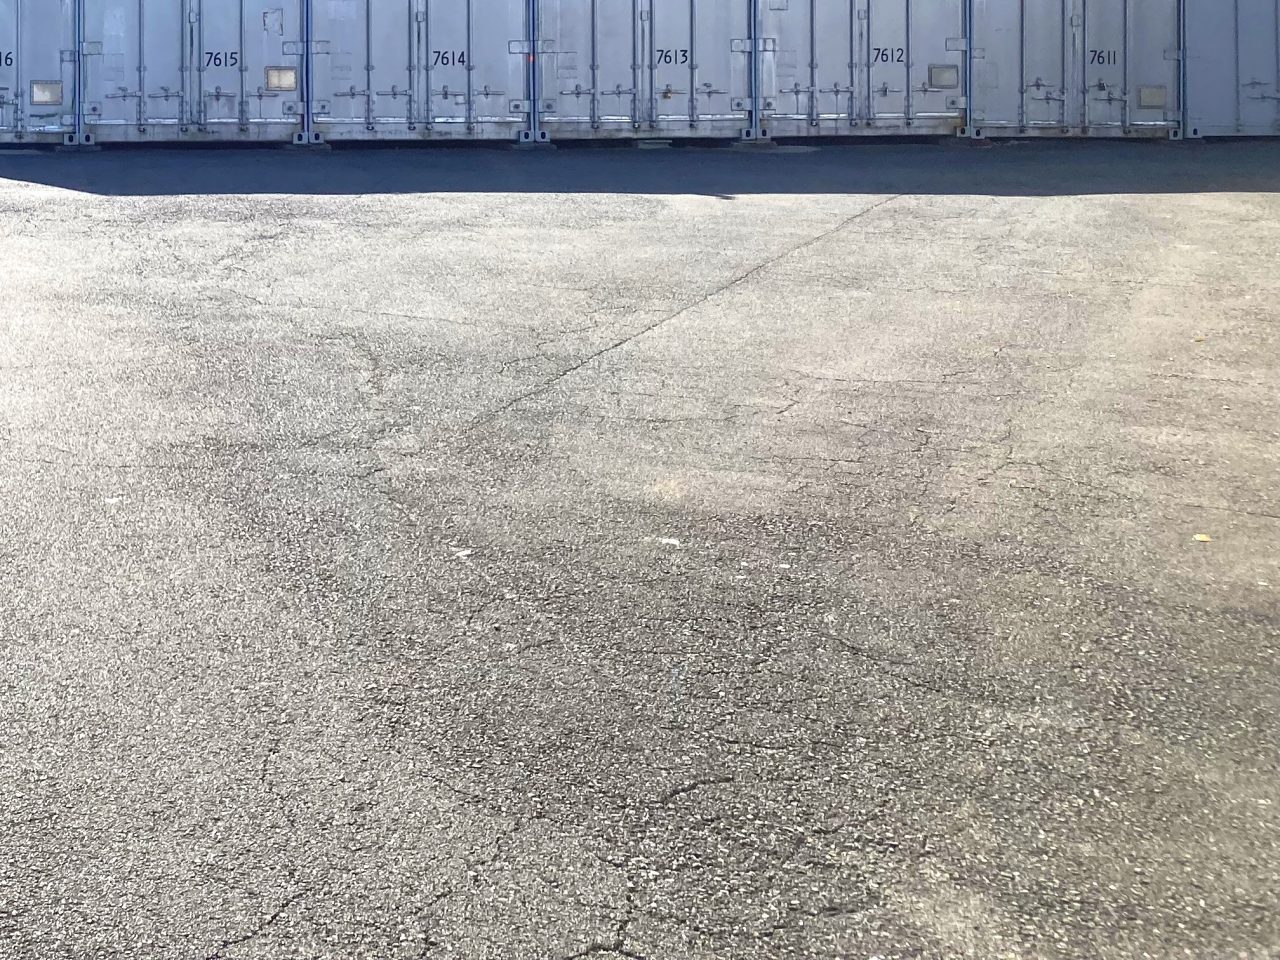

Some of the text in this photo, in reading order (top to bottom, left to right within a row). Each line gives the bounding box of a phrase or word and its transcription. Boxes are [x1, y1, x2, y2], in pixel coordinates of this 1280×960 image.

[205, 52, 238, 67] 7615
[432, 50, 466, 67] 7614
[656, 49, 688, 65] 7613
[873, 48, 904, 63] 7612
[1089, 50, 1116, 65] 7611
